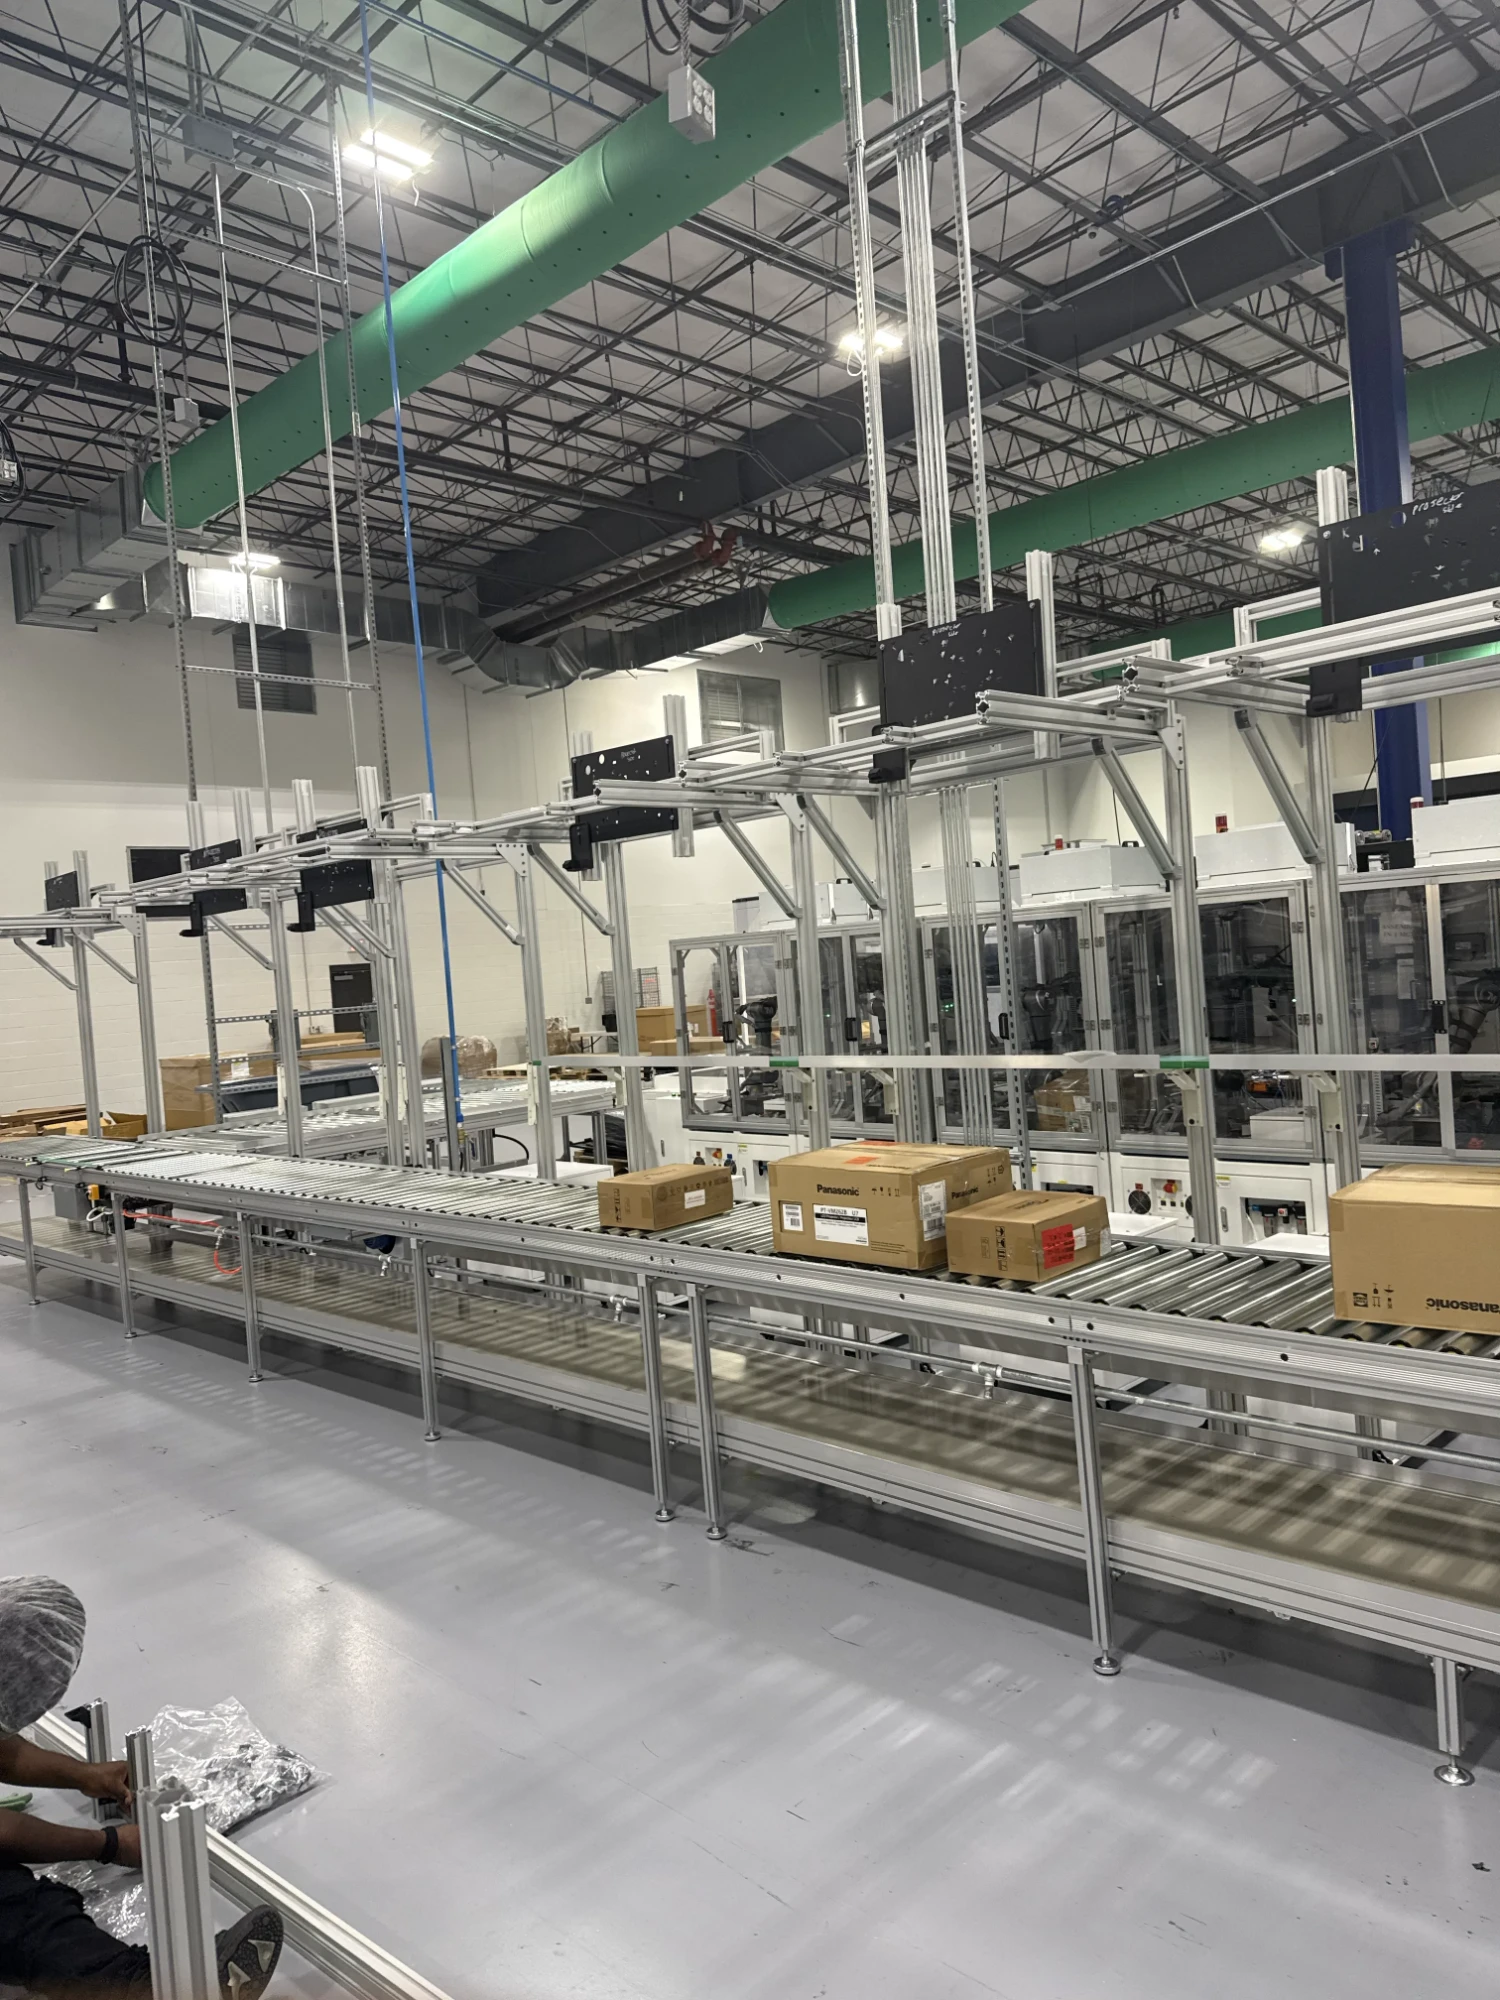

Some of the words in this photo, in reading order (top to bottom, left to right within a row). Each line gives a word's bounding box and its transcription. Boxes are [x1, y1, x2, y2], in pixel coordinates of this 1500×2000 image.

[816, 1184, 860, 1197] Panasonic
[951, 1186, 979, 1199] Panasonic
[1426, 1297, 1500, 1314] anasonic
